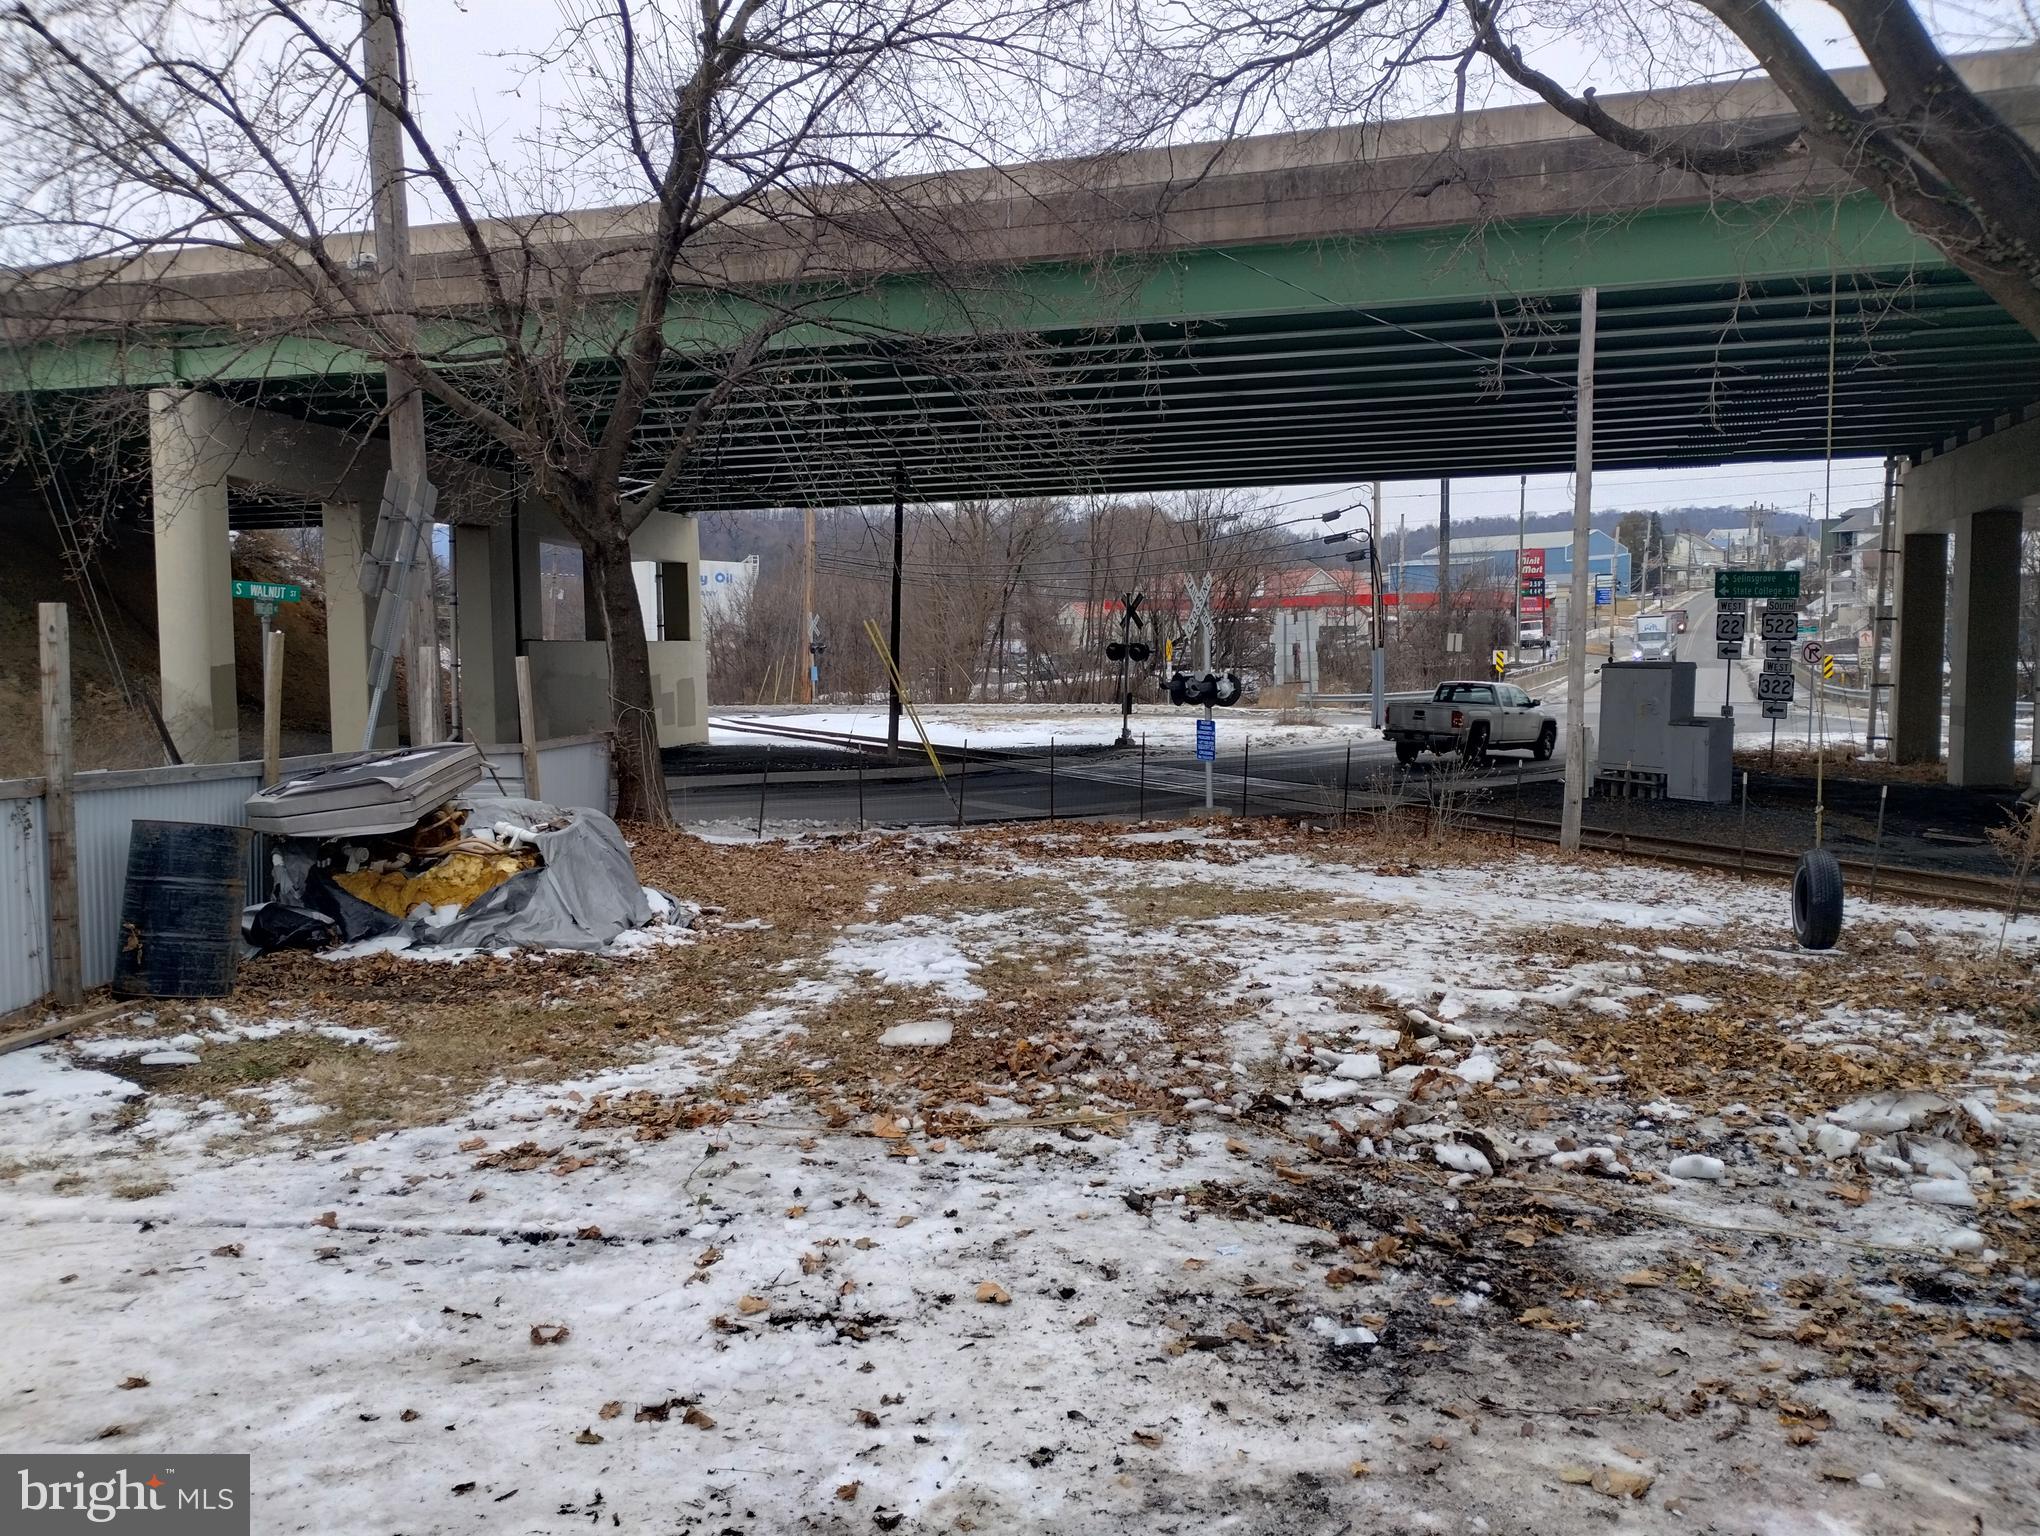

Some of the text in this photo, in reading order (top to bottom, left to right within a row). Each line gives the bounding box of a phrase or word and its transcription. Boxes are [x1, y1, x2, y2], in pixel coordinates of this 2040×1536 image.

[715, 572, 733, 584] Oil
[1732, 574, 1777, 585] Selinsgrove
[235, 582, 242, 595] S
[250, 583, 286, 599] WALNUT
[1733, 587, 1796, 598] State College 30
[1720, 601, 1742, 611] WEST
[1768, 601, 1794, 611] SOUTH
[1721, 619, 1740, 634] 22
[1765, 618, 1795, 633] 522
[1767, 661, 1789, 672] WEST
[1761, 678, 1791, 695] 322
